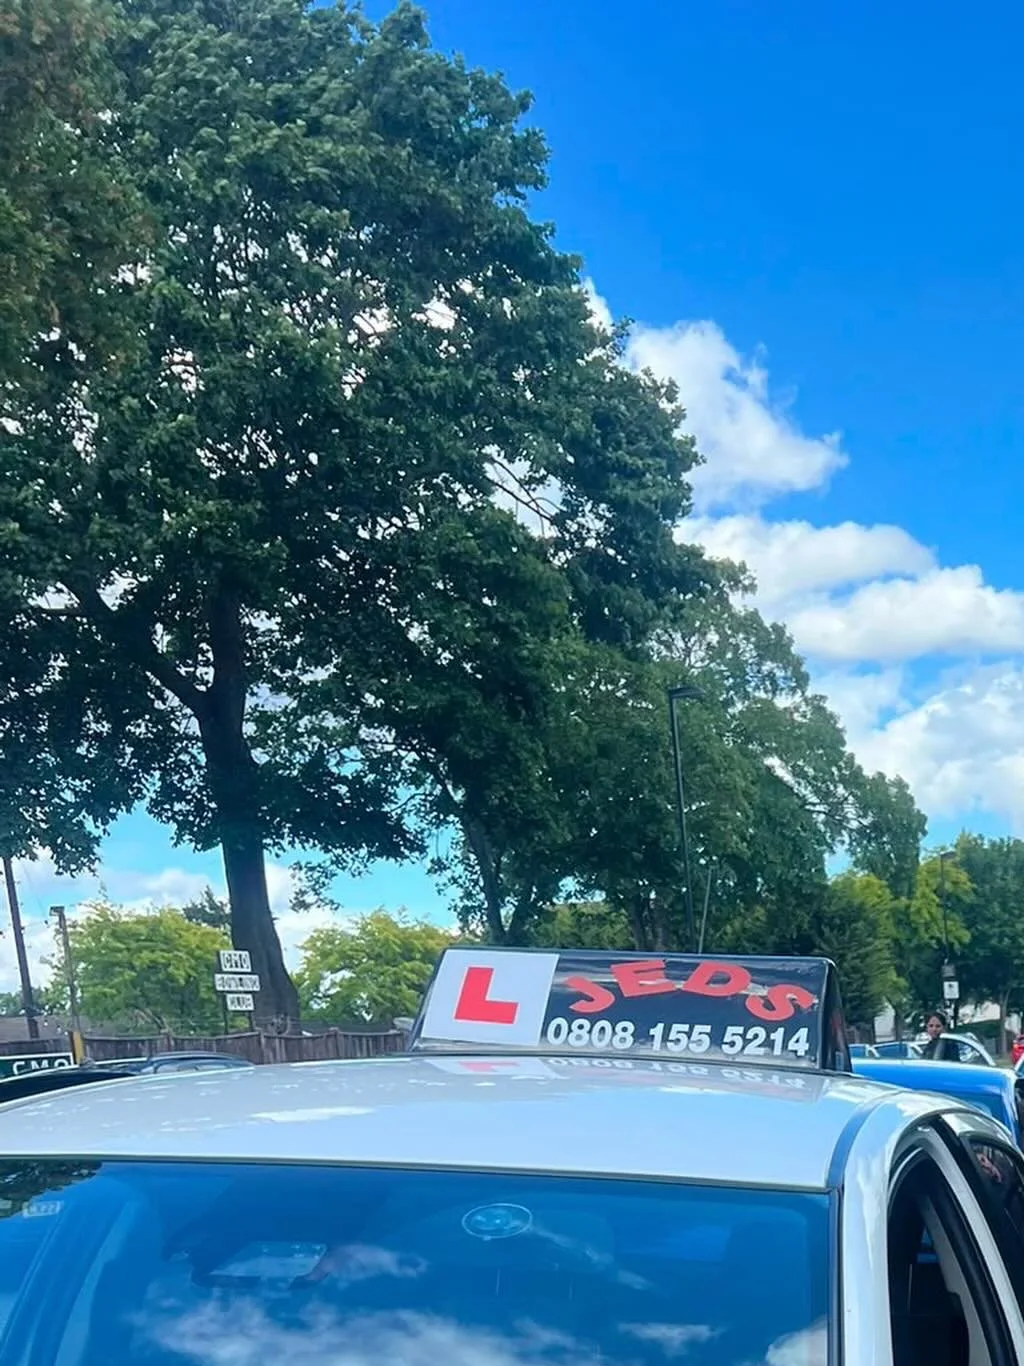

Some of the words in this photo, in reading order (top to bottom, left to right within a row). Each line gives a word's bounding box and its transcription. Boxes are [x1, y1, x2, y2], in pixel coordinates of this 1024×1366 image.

[454, 966, 518, 1024] L
[563, 959, 815, 1021] JEDS
[546, 1017, 636, 1050] 0808
[649, 1022, 712, 1054] 155
[721, 1026, 810, 1057] 5214
